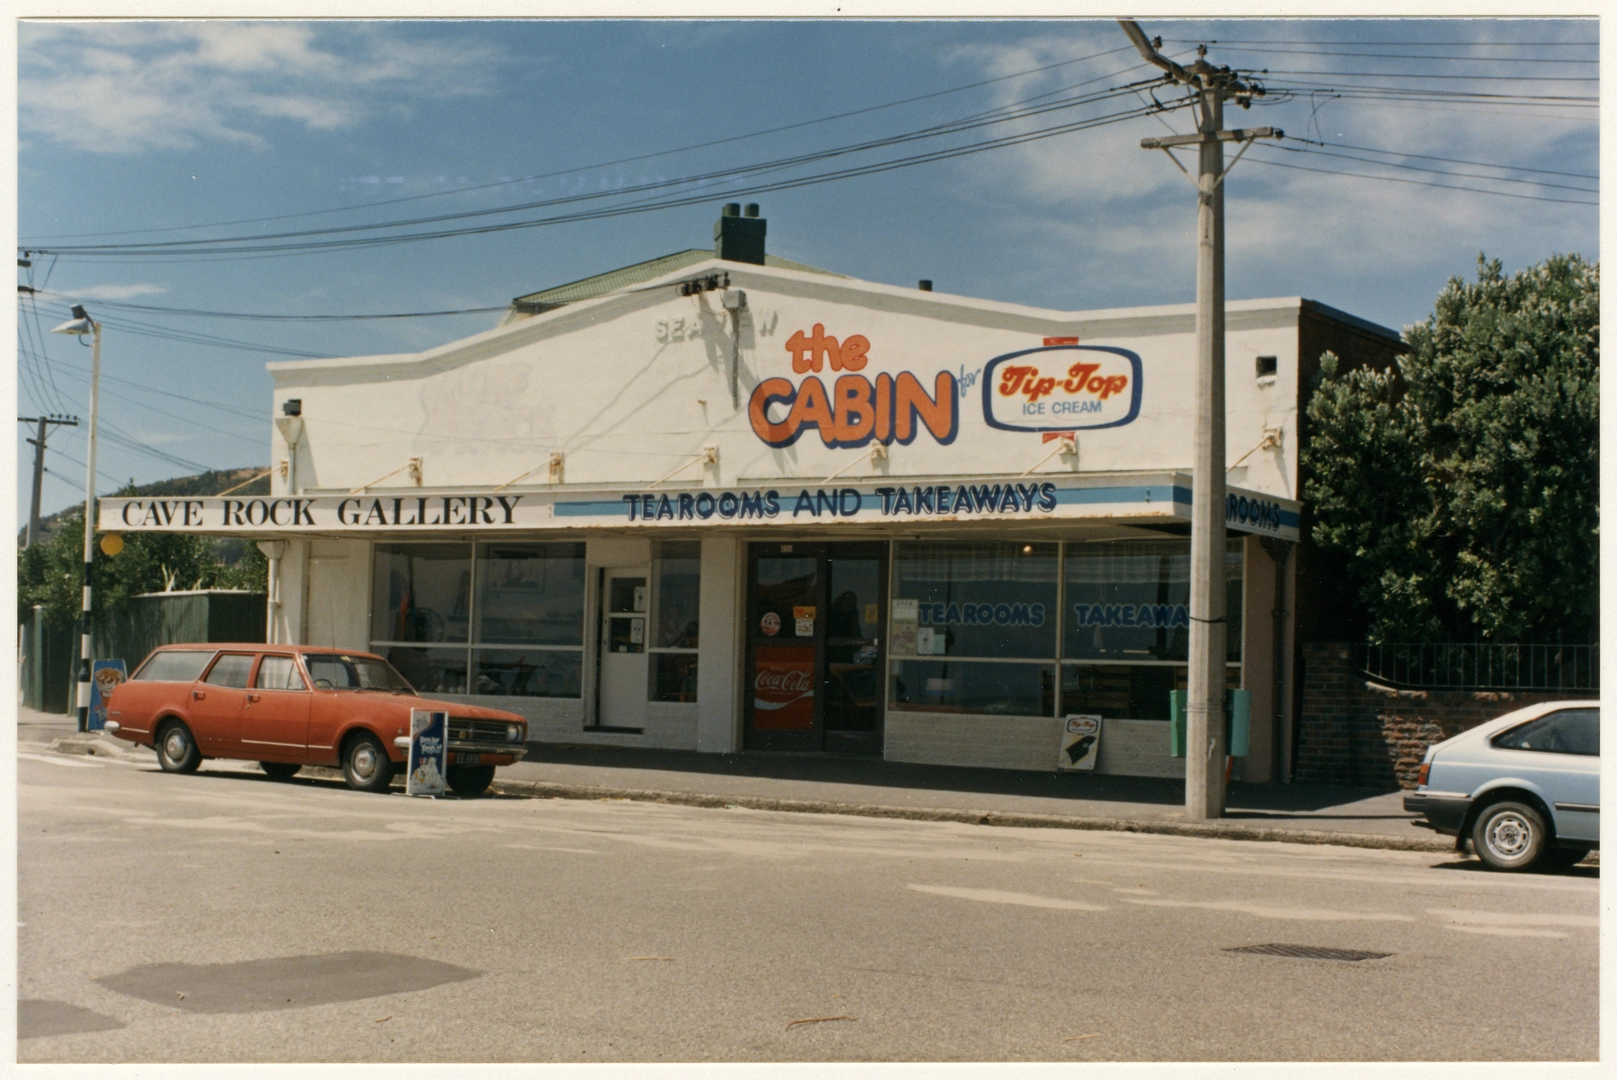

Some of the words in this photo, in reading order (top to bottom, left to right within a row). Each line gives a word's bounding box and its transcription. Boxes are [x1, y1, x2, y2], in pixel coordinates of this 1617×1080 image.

[785, 323, 870, 374] the
[957, 364, 981, 398] for
[998, 361, 1128, 403] Tip-Top
[748, 370, 959, 450] CABIN
[1022, 402, 1045, 416] ICE
[1051, 400, 1102, 415] CREAM
[122, 501, 204, 526] CAVE
[221, 499, 318, 526] ROCK
[337, 495, 524, 525] GALLERY
[622, 490, 781, 521] TEAROOMS
[793, 488, 862, 518] AND
[875, 482, 1057, 515] TAKEAWAYS
[1225, 493, 1281, 531] ROOMS
[919, 602, 1045, 627] TEAROOMS
[1074, 603, 1190, 628] TAKEAWA
